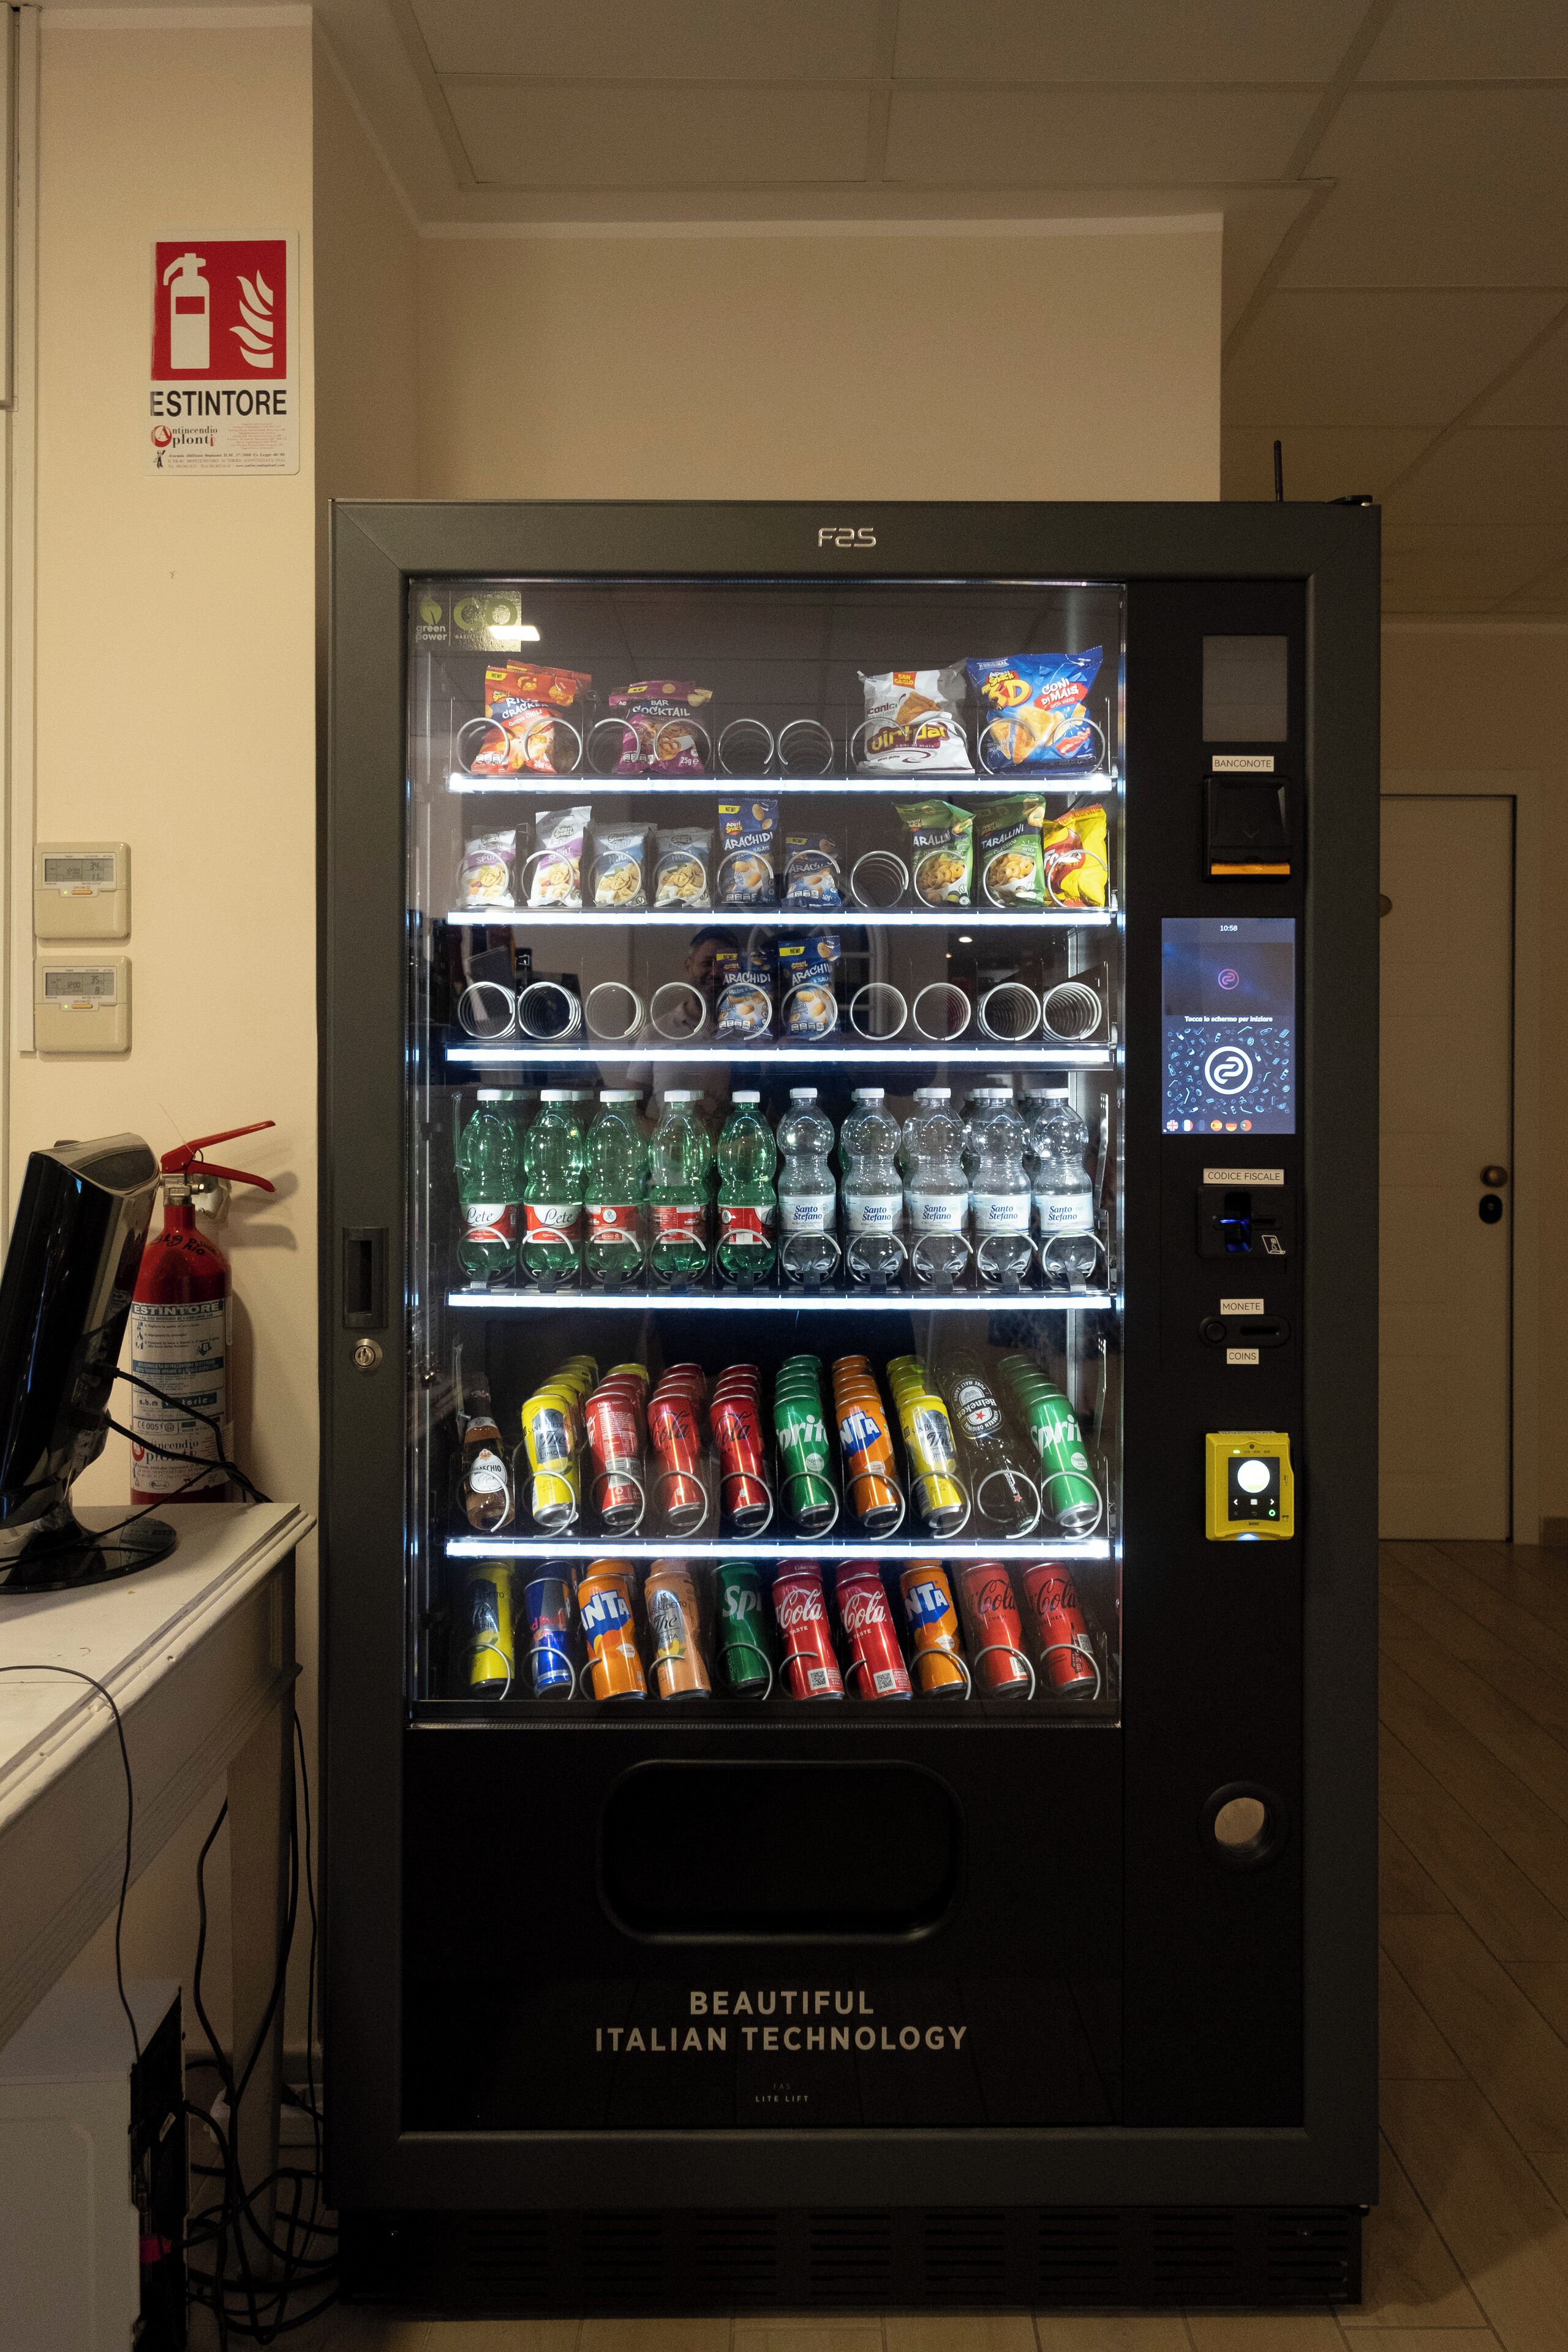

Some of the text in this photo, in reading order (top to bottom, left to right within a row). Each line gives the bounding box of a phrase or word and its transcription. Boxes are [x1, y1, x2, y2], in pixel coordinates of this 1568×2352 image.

[150, 390, 287, 417] ESTINTORE
[416, 625, 446, 634] green
[415, 633, 448, 643] power
[1041, 677, 1071, 695] CONI
[1051, 684, 1079, 702] MAIS
[982, 679, 1031, 709] 3D
[526, 709, 543, 718] CHILI
[633, 705, 690, 717] COCKTAIL
[680, 756, 692, 765] 25g
[725, 832, 773, 851] ARACHIDI
[981, 823, 1024, 850] TARALLINI
[723, 972, 771, 985] ARACHIDI
[1208, 1172, 1281, 1181] CODICE FISCALE
[466, 1207, 494, 1224] Lete
[541, 1208, 573, 1226] Lete
[793, 1212, 823, 1222] Stefano
[862, 1213, 891, 1223] Stefano
[922, 1212, 951, 1221] Stefano
[989, 1212, 1018, 1221] Stefano
[1048, 1213, 1077, 1222] Stefano
[134, 1302, 219, 1315] ESTINTORE
[1223, 1302, 1261, 1311] MONETE
[957, 1398, 997, 1420] Heineken
[652, 1410, 692, 1447] Cola
[714, 1411, 753, 1447] Cola
[776, 1414, 829, 1452] prit
[964, 1423, 984, 1432] ORIGINAL
[1036, 1578, 1078, 1616] Cola
[780, 1589, 822, 1629] Cola
[843, 1591, 886, 1634] Cola
[789, 1626, 809, 1635] TASTE
[854, 1629, 872, 1639] TASTE
[690, 1991, 874, 2015] BEAUTIFUL
[596, 2026, 967, 2052] ITALIAN TECHNOLOGY
